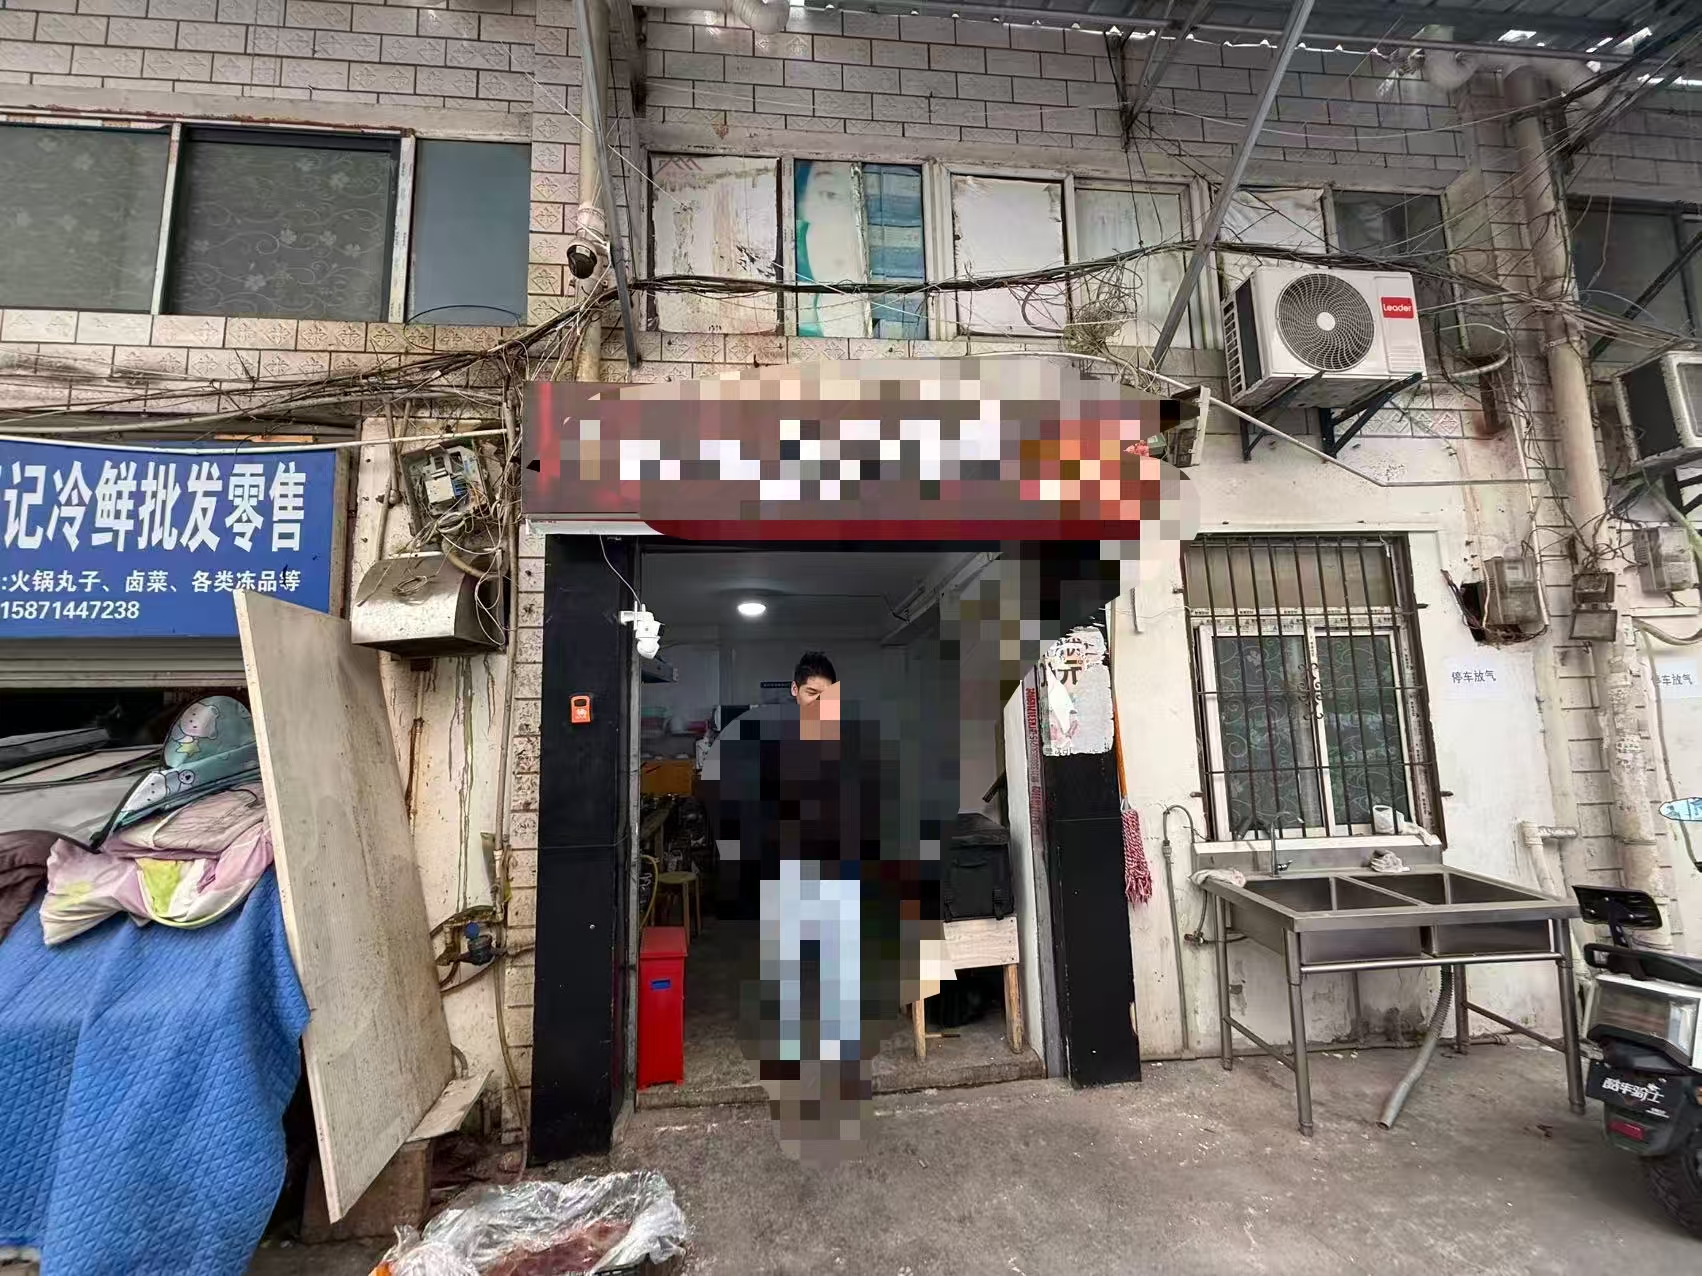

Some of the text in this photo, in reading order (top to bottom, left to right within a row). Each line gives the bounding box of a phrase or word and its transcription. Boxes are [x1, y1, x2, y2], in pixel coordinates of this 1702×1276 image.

[1383, 303, 1412, 312] Leader
[0, 460, 306, 552] 记冷鲜批发零售
[1, 600, 140, 620] 15871447238
[1451, 669, 1497, 683] 停车放气
